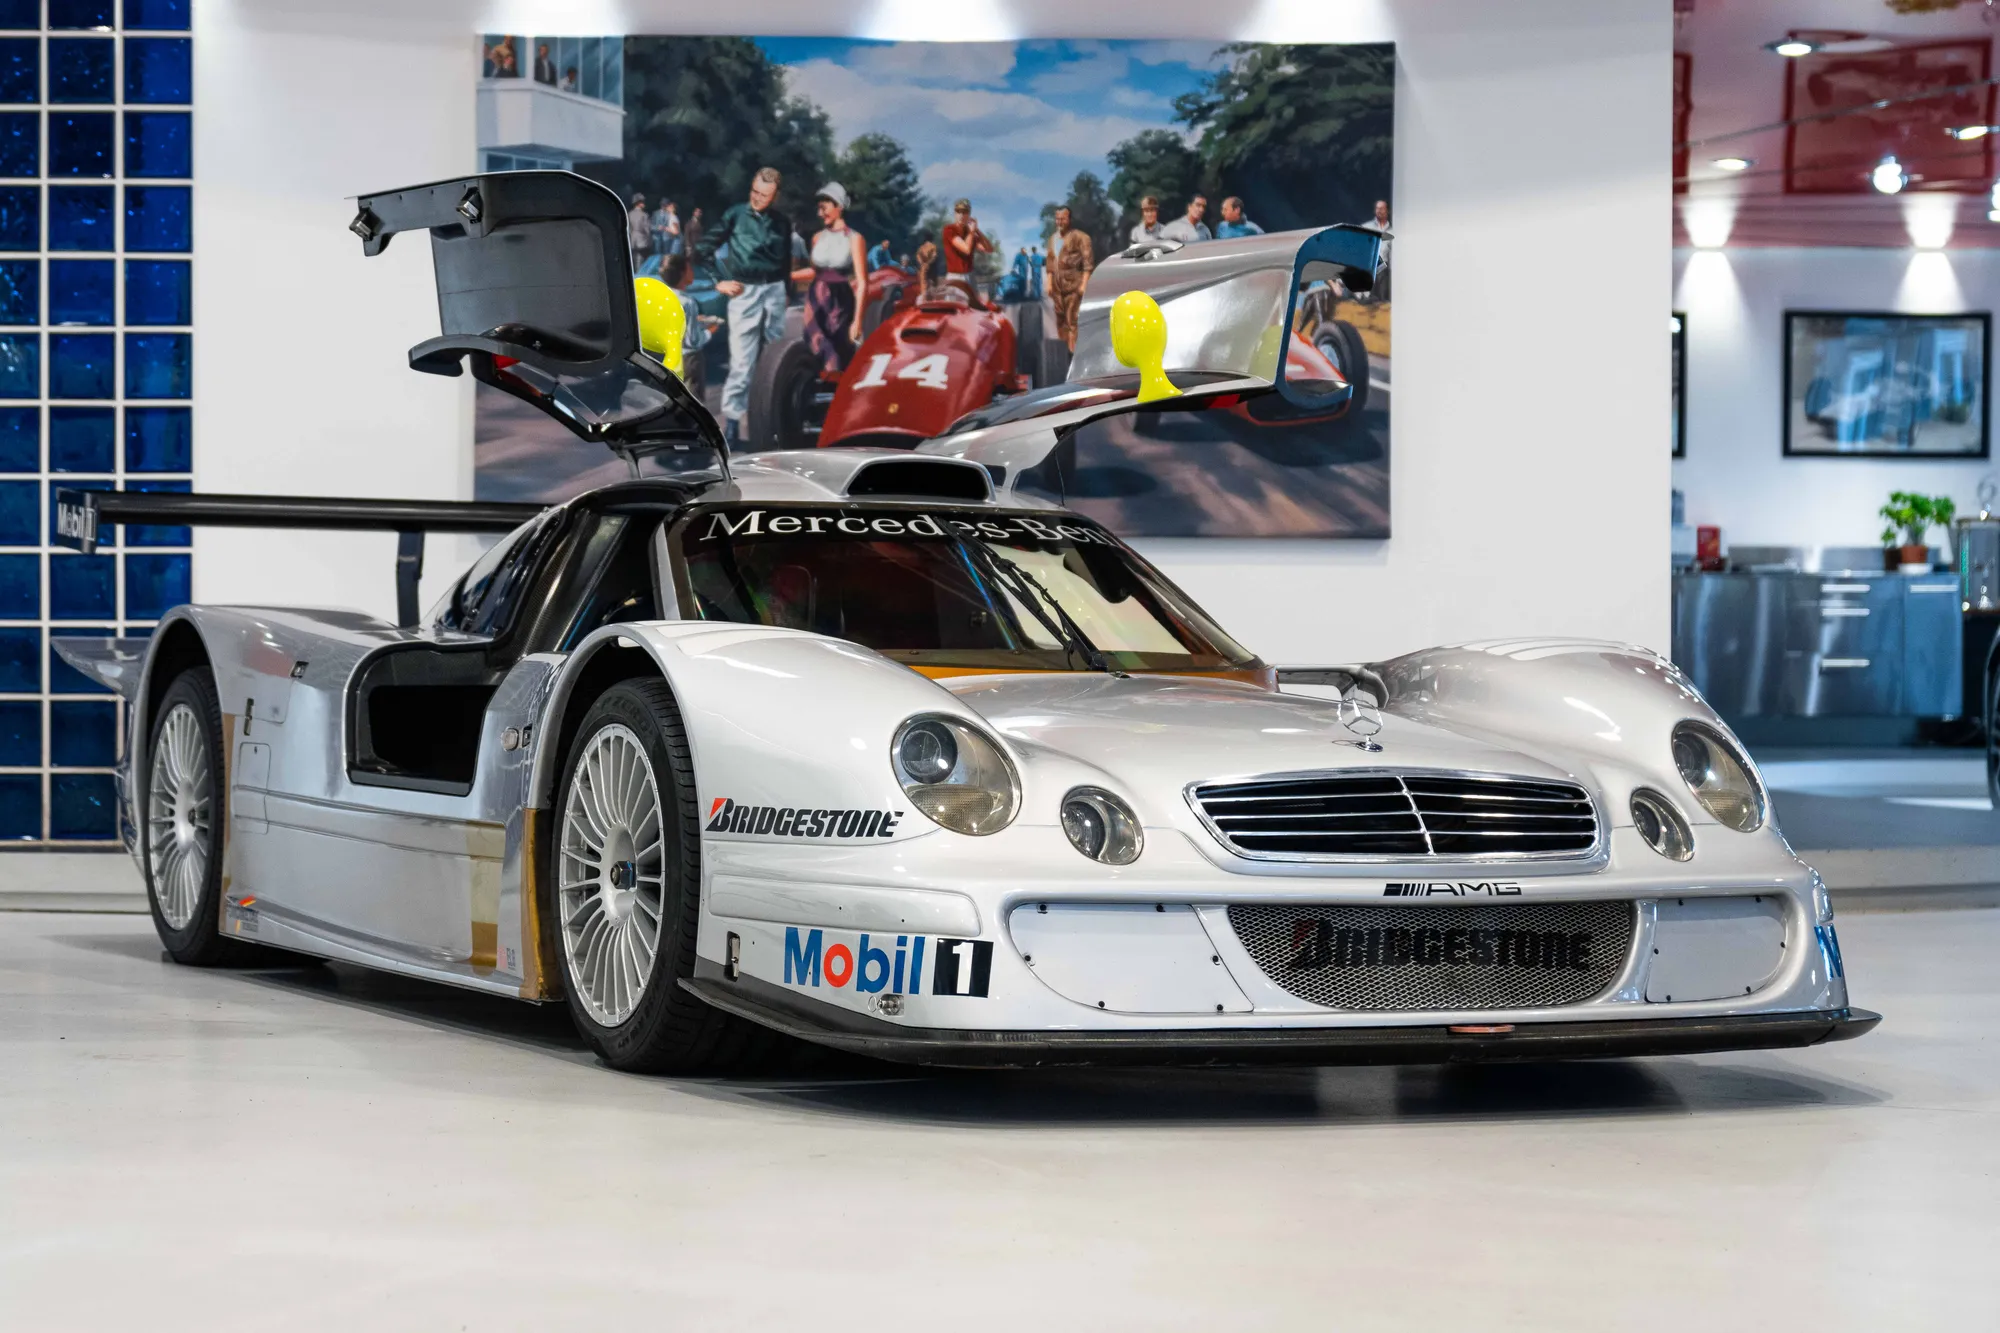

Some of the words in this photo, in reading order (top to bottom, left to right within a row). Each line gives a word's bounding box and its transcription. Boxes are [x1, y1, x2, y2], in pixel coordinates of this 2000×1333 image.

[852, 353, 950, 391] 14
[57, 502, 84, 539] Mobil
[699, 510, 1120, 548] Mercedes-Ben
[705, 797, 904, 838] BRIDGESTONE
[1426, 882, 1522, 896] AMG
[783, 926, 926, 995] Mobil
[952, 941, 975, 994] 1
